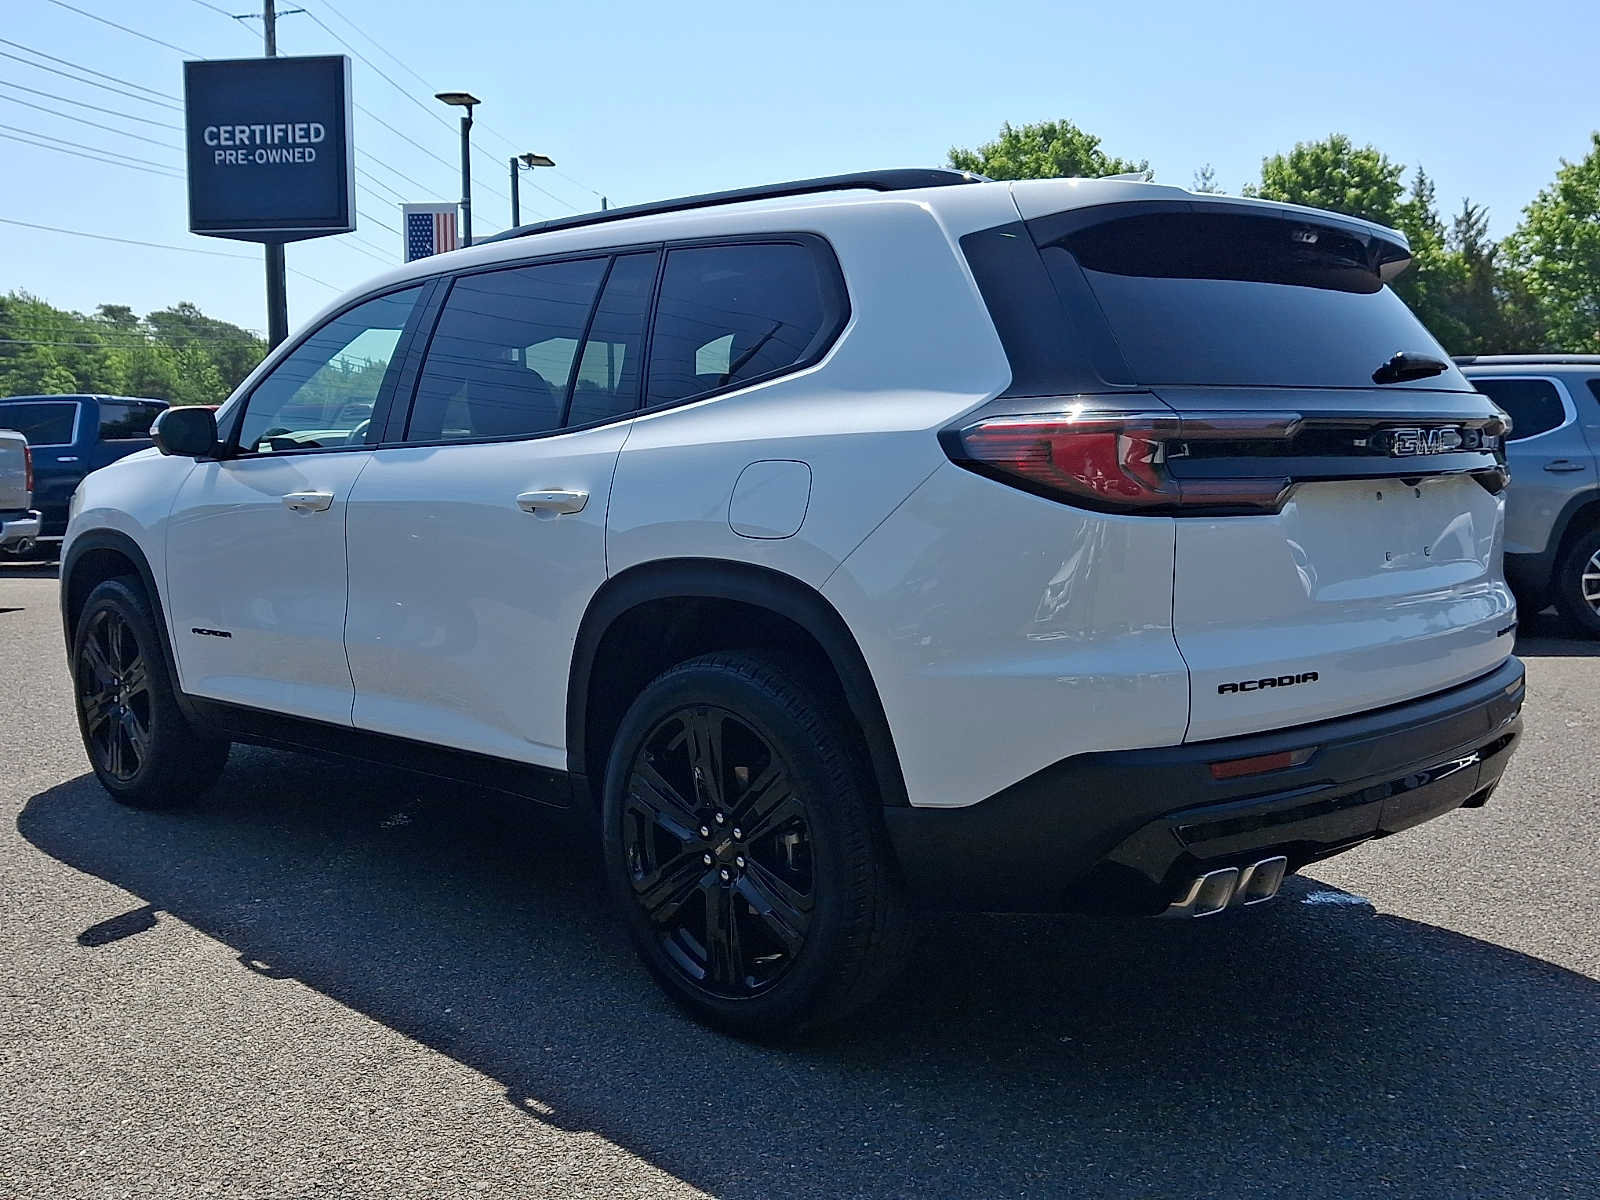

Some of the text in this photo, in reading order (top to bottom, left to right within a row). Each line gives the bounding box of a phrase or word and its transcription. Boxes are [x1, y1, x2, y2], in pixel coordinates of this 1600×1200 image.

[204, 122, 325, 146] CERTIFIED
[214, 147, 316, 165] PRE-OWNED
[1393, 428, 1462, 456] GMC
[191, 627, 232, 639] ACADIA
[1217, 671, 1319, 695] ACADIA
